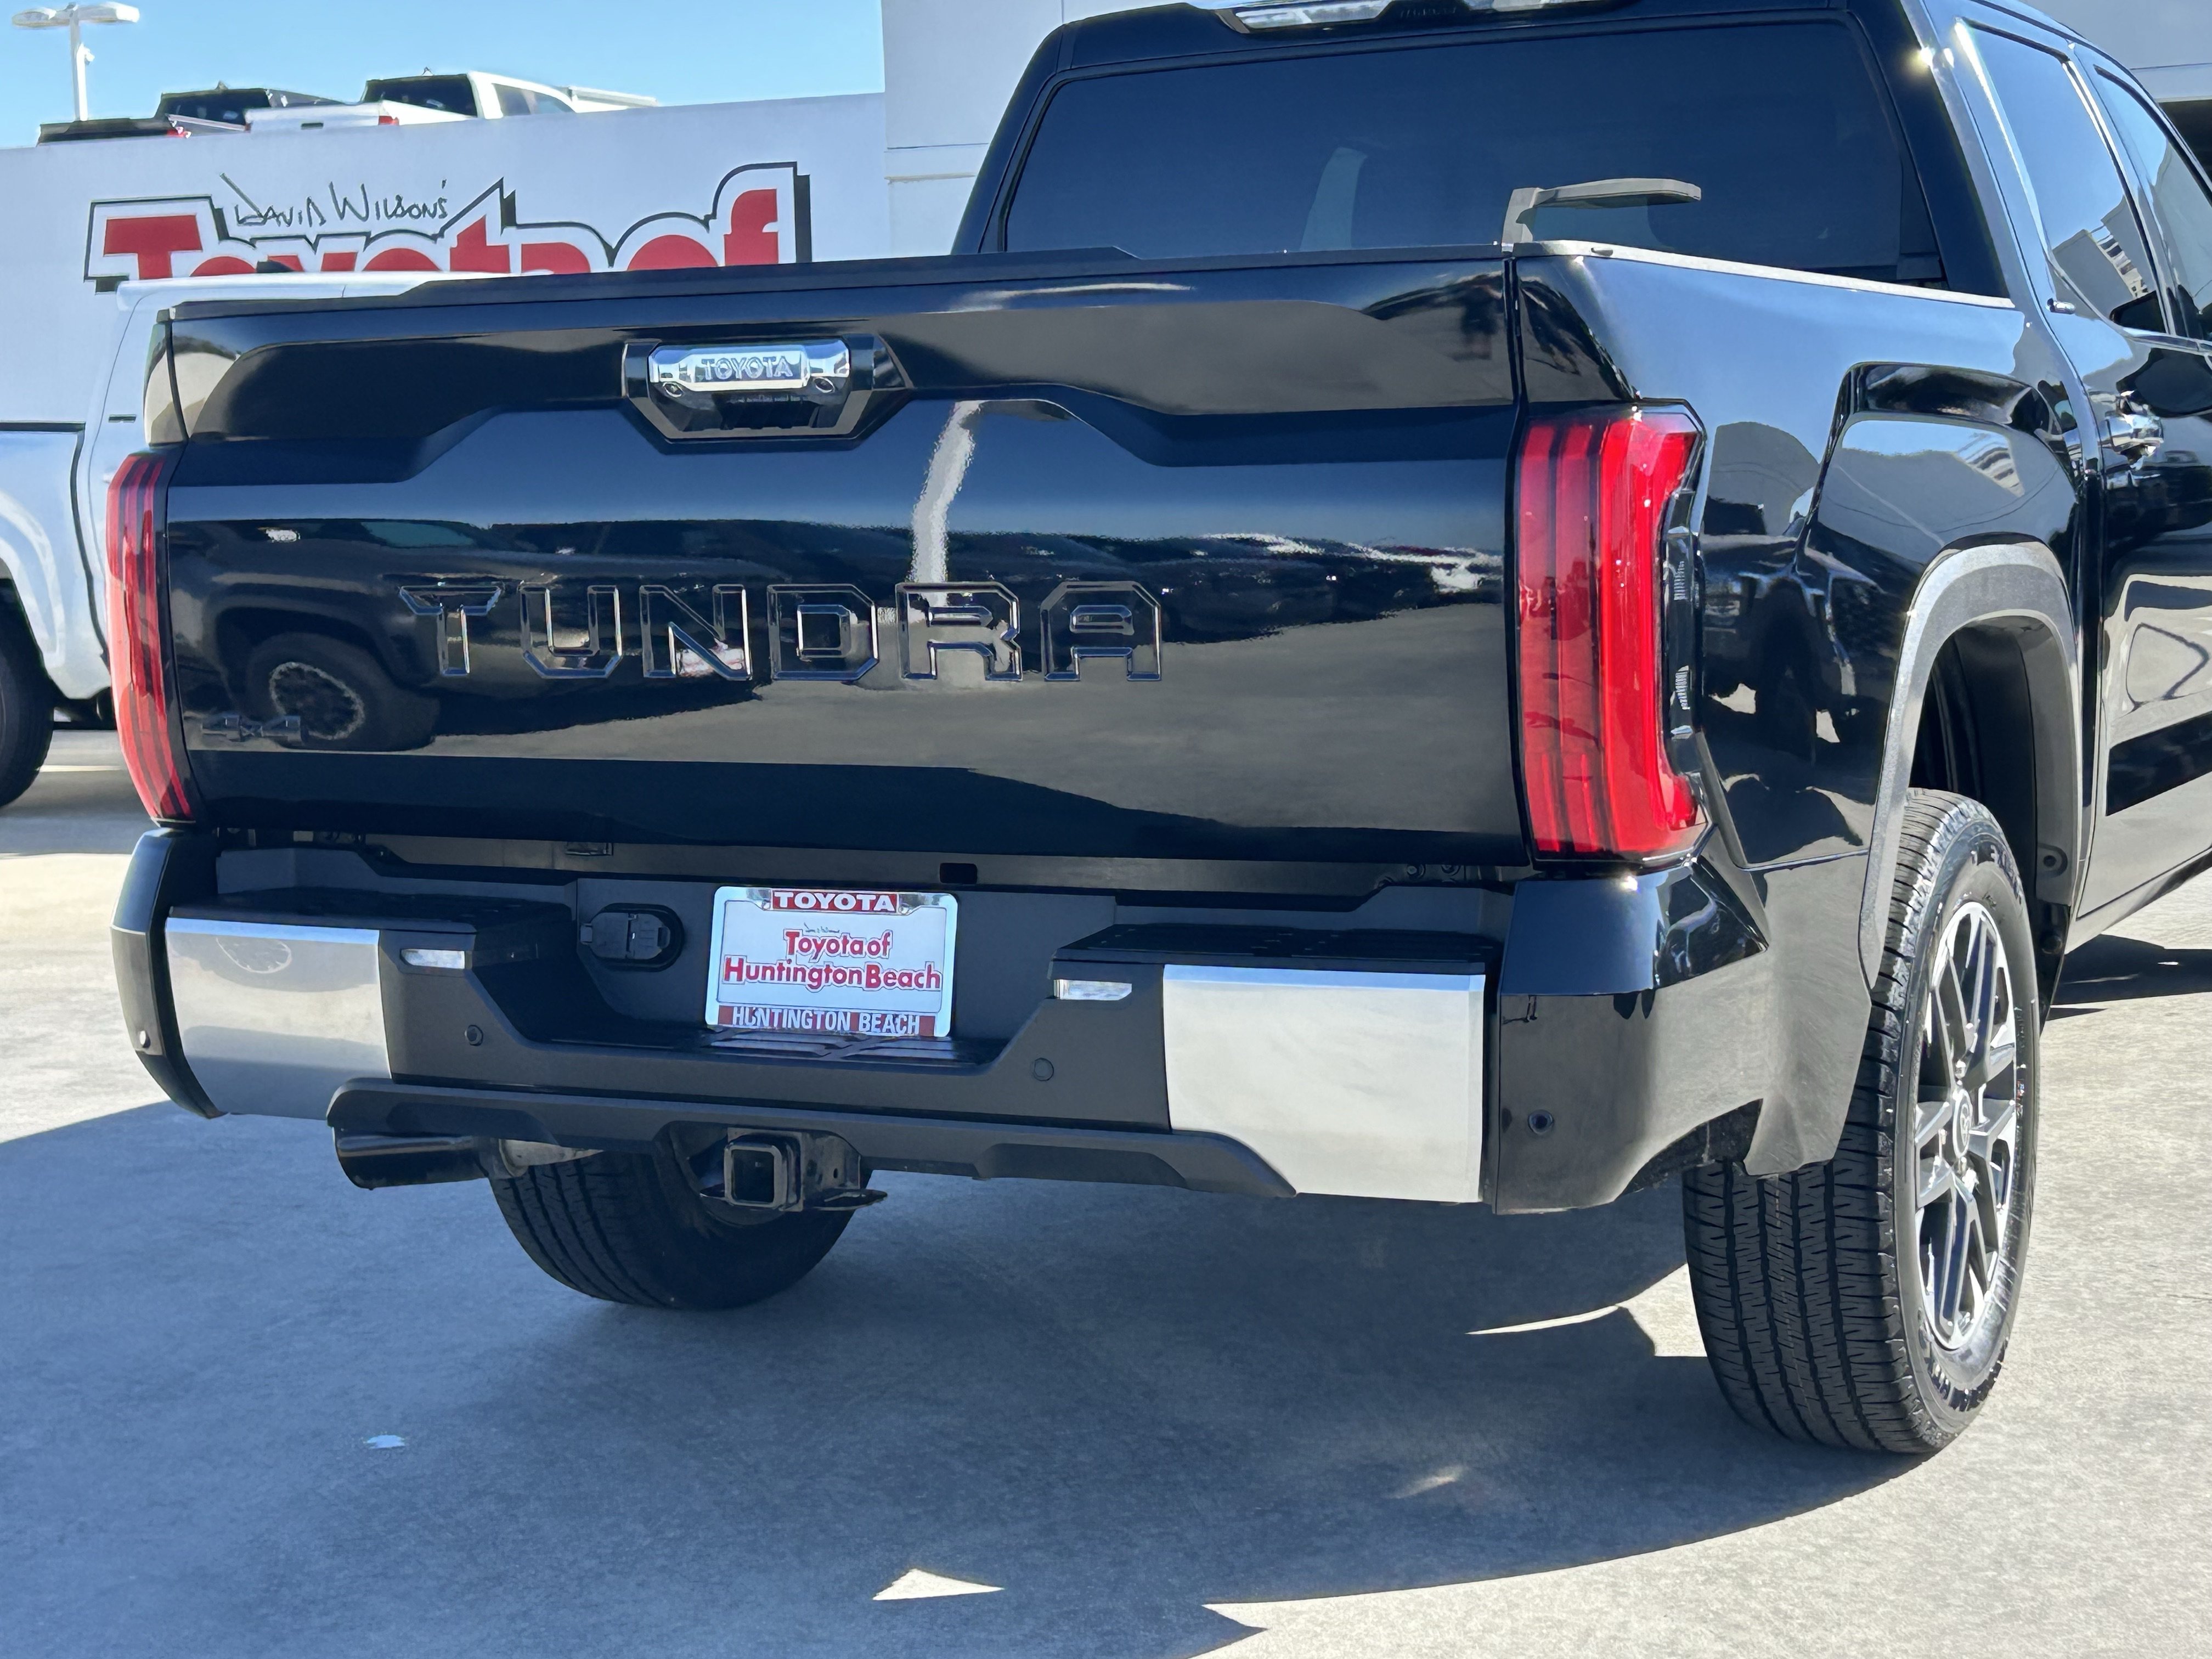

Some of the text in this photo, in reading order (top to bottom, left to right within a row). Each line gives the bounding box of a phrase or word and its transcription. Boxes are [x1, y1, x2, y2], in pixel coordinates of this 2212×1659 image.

[701, 356, 793, 381] TOYOTA
[399, 580, 1163, 682] TUNDRA
[774, 891, 896, 912] TOYOTA
[785, 931, 890, 961] Toyota of
[724, 957, 940, 990] Huntington Beach
[732, 1006, 920, 1035] HUNTINGTON BEACH
